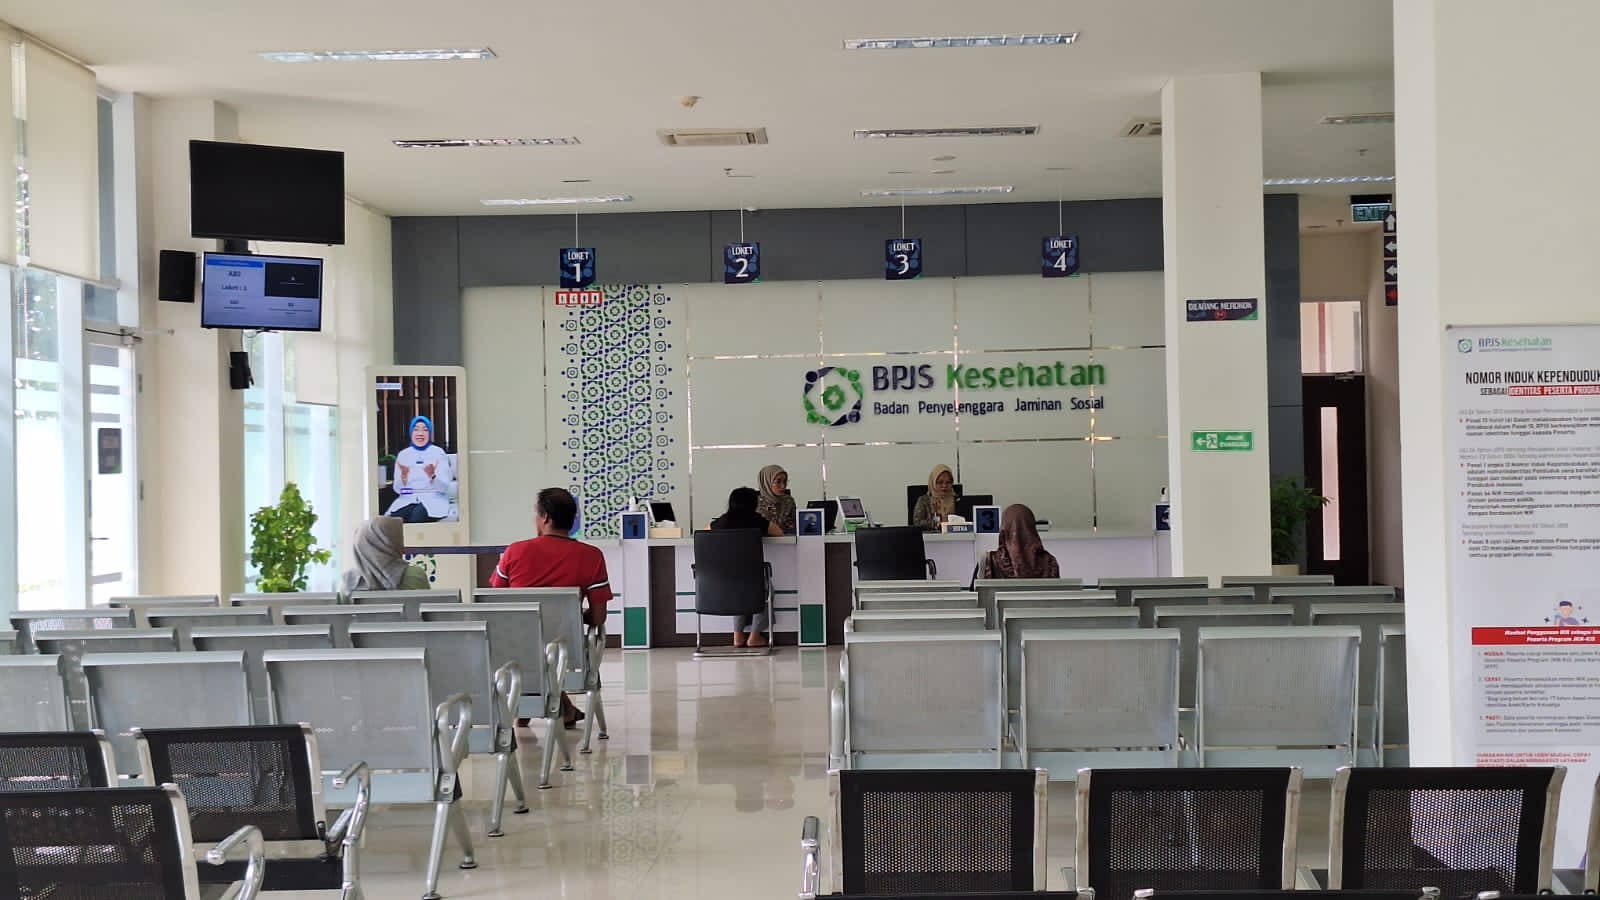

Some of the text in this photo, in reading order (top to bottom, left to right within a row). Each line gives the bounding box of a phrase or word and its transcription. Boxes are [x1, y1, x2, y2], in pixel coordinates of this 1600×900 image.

[732, 246, 753, 256] LOKET
[893, 242, 915, 251] LOKET
[1051, 240, 1072, 249] LOKET
[567, 251, 589, 260] LOKET
[896, 254, 909, 275] 3
[1053, 251, 1067, 272] 4
[572, 262, 581, 283] 1
[735, 257, 749, 278] 2
[871, 360, 1106, 392] BPJS Kesehatan
[1465, 371, 1501, 385] NOMOR
[1504, 371, 1535, 383] INDUK
[1480, 387, 1507, 396] SEBAGAI
[1509, 387, 1543, 396] IDENTITAS
[1543, 386, 1573, 395] PESERTA
[873, 396, 1105, 416] Badan Penyelenggara Jaminan Sosial
[981, 510, 995, 531] 3
